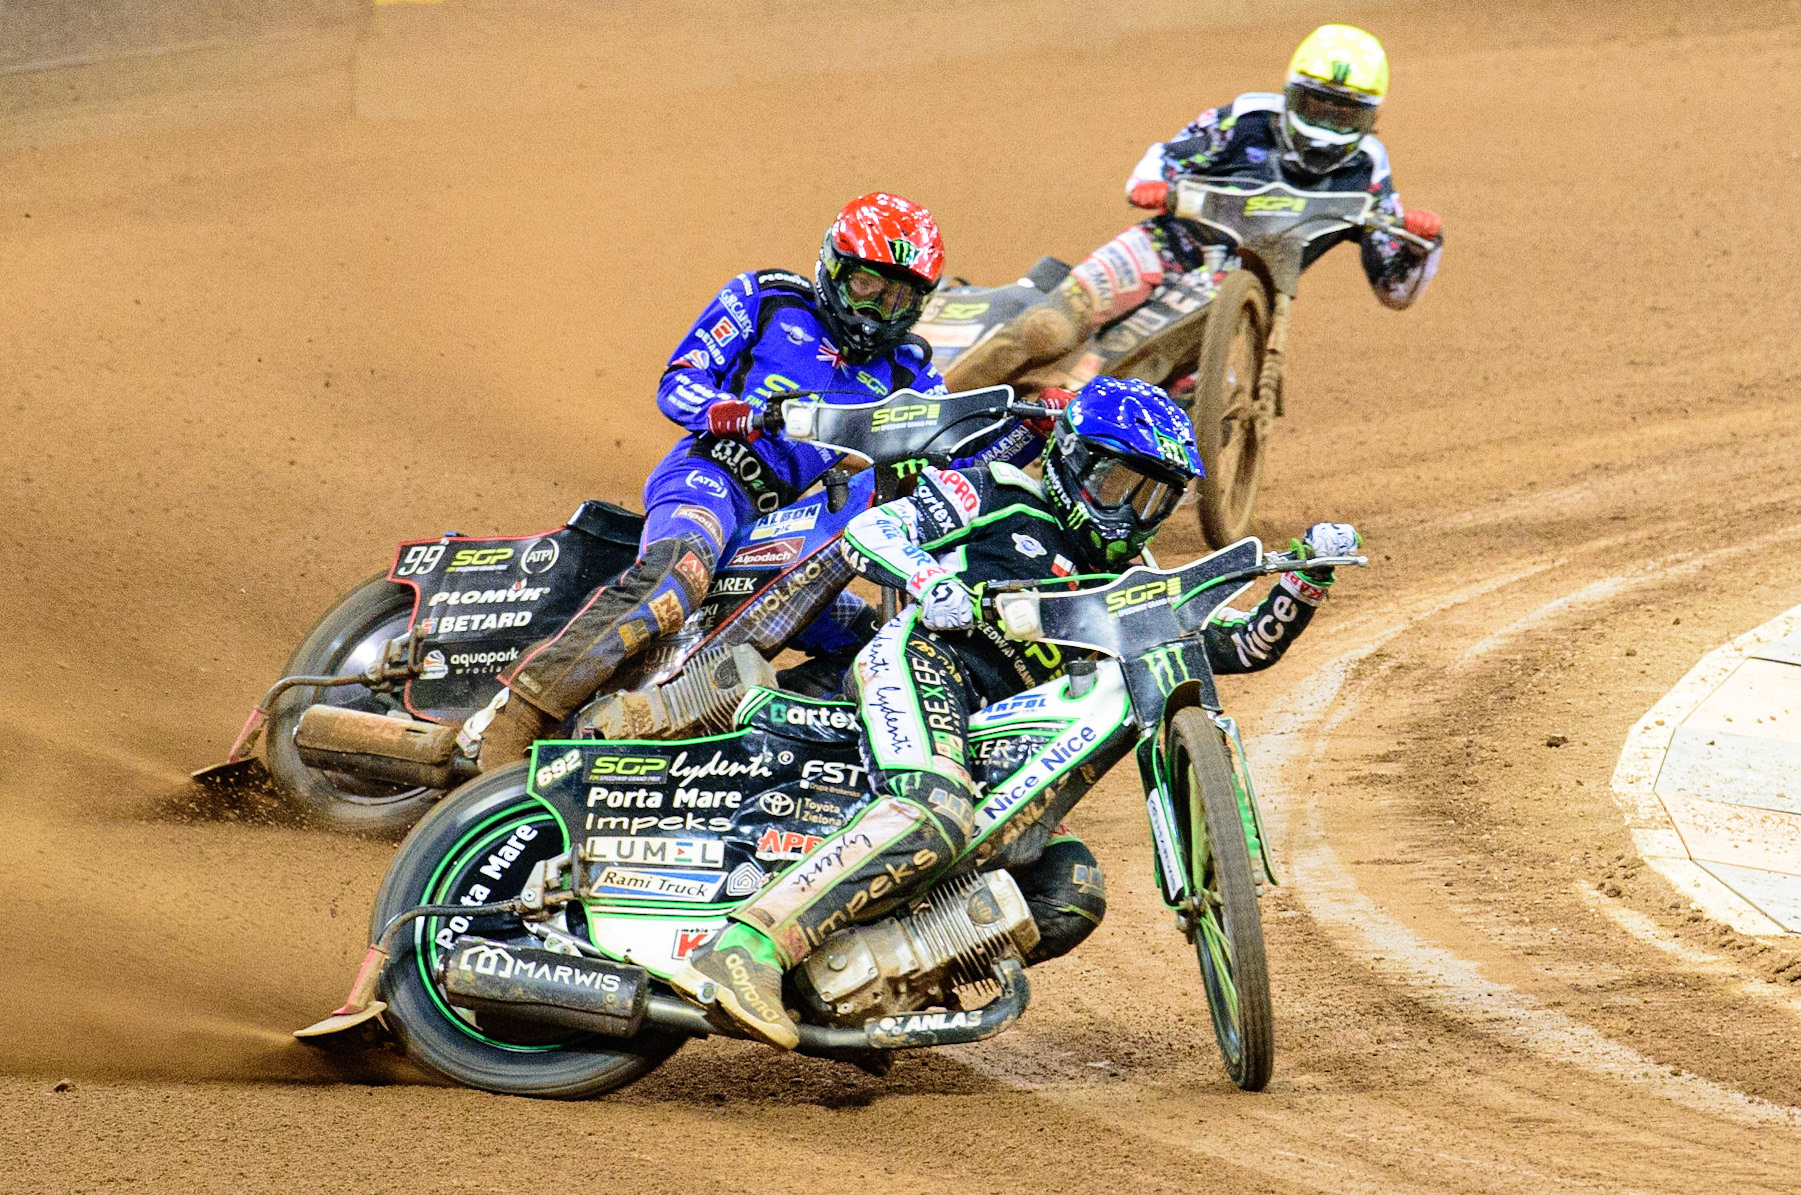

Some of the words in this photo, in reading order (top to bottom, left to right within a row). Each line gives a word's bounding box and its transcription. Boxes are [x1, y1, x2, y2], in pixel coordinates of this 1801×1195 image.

[694, 328, 726, 366] BETARD
[855, 370, 889, 396] SGP
[397, 545, 447, 576] 99
[450, 548, 514, 567] SGP
[527, 549, 553, 563] ATPI
[732, 551, 792, 565] Alpodach
[712, 577, 757, 593] AREK
[438, 611, 533, 634] BETARD
[450, 647, 519, 668] aquapark
[1040, 726, 1097, 773] Nice
[536, 749, 583, 788] 692
[591, 756, 667, 775] SGP
[669, 750, 773, 787] lydenti
[801, 759, 866, 788] FST
[586, 786, 664, 809] Porta
[672, 789, 742, 809] Mare
[804, 797, 841, 814] Toyota
[983, 776, 1040, 820] Nice
[585, 812, 733, 836] Impeks
[801, 811, 842, 827] Zielona
[589, 840, 720, 864] LUMEL
[435, 883, 491, 950] Pota
[479, 824, 539, 881] Mare
[604, 870, 651, 889] Rami
[659, 876, 710, 897] Truck
[514, 958, 622, 993] MARWIS
[903, 1010, 984, 1033] ANLAS
